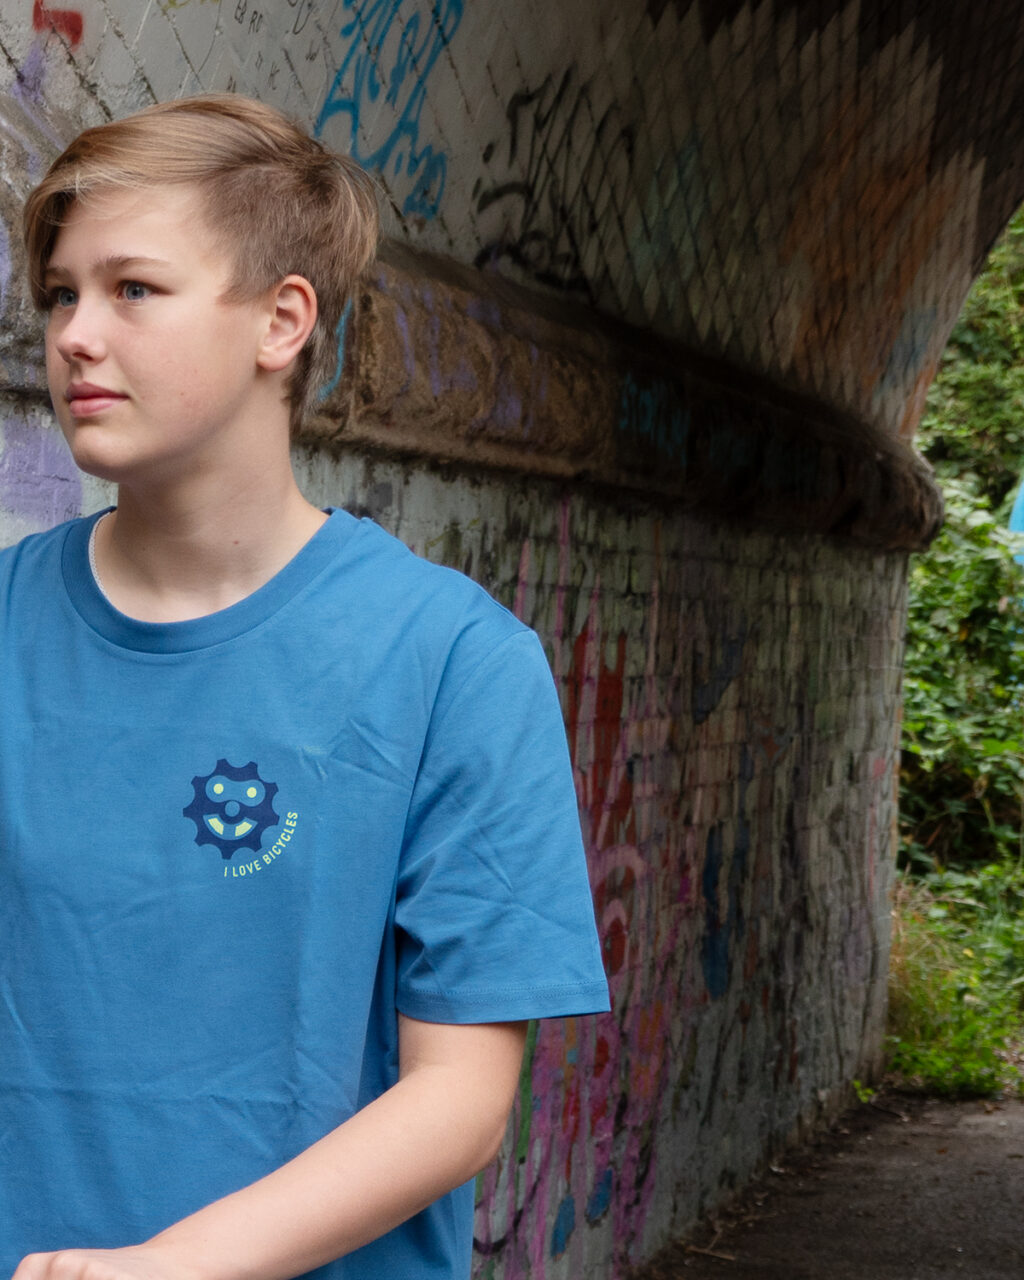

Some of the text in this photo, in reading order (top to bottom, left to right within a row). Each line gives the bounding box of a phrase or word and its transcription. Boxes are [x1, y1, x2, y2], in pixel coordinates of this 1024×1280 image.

[224, 811, 298, 877] I LOVE BICYCLES
